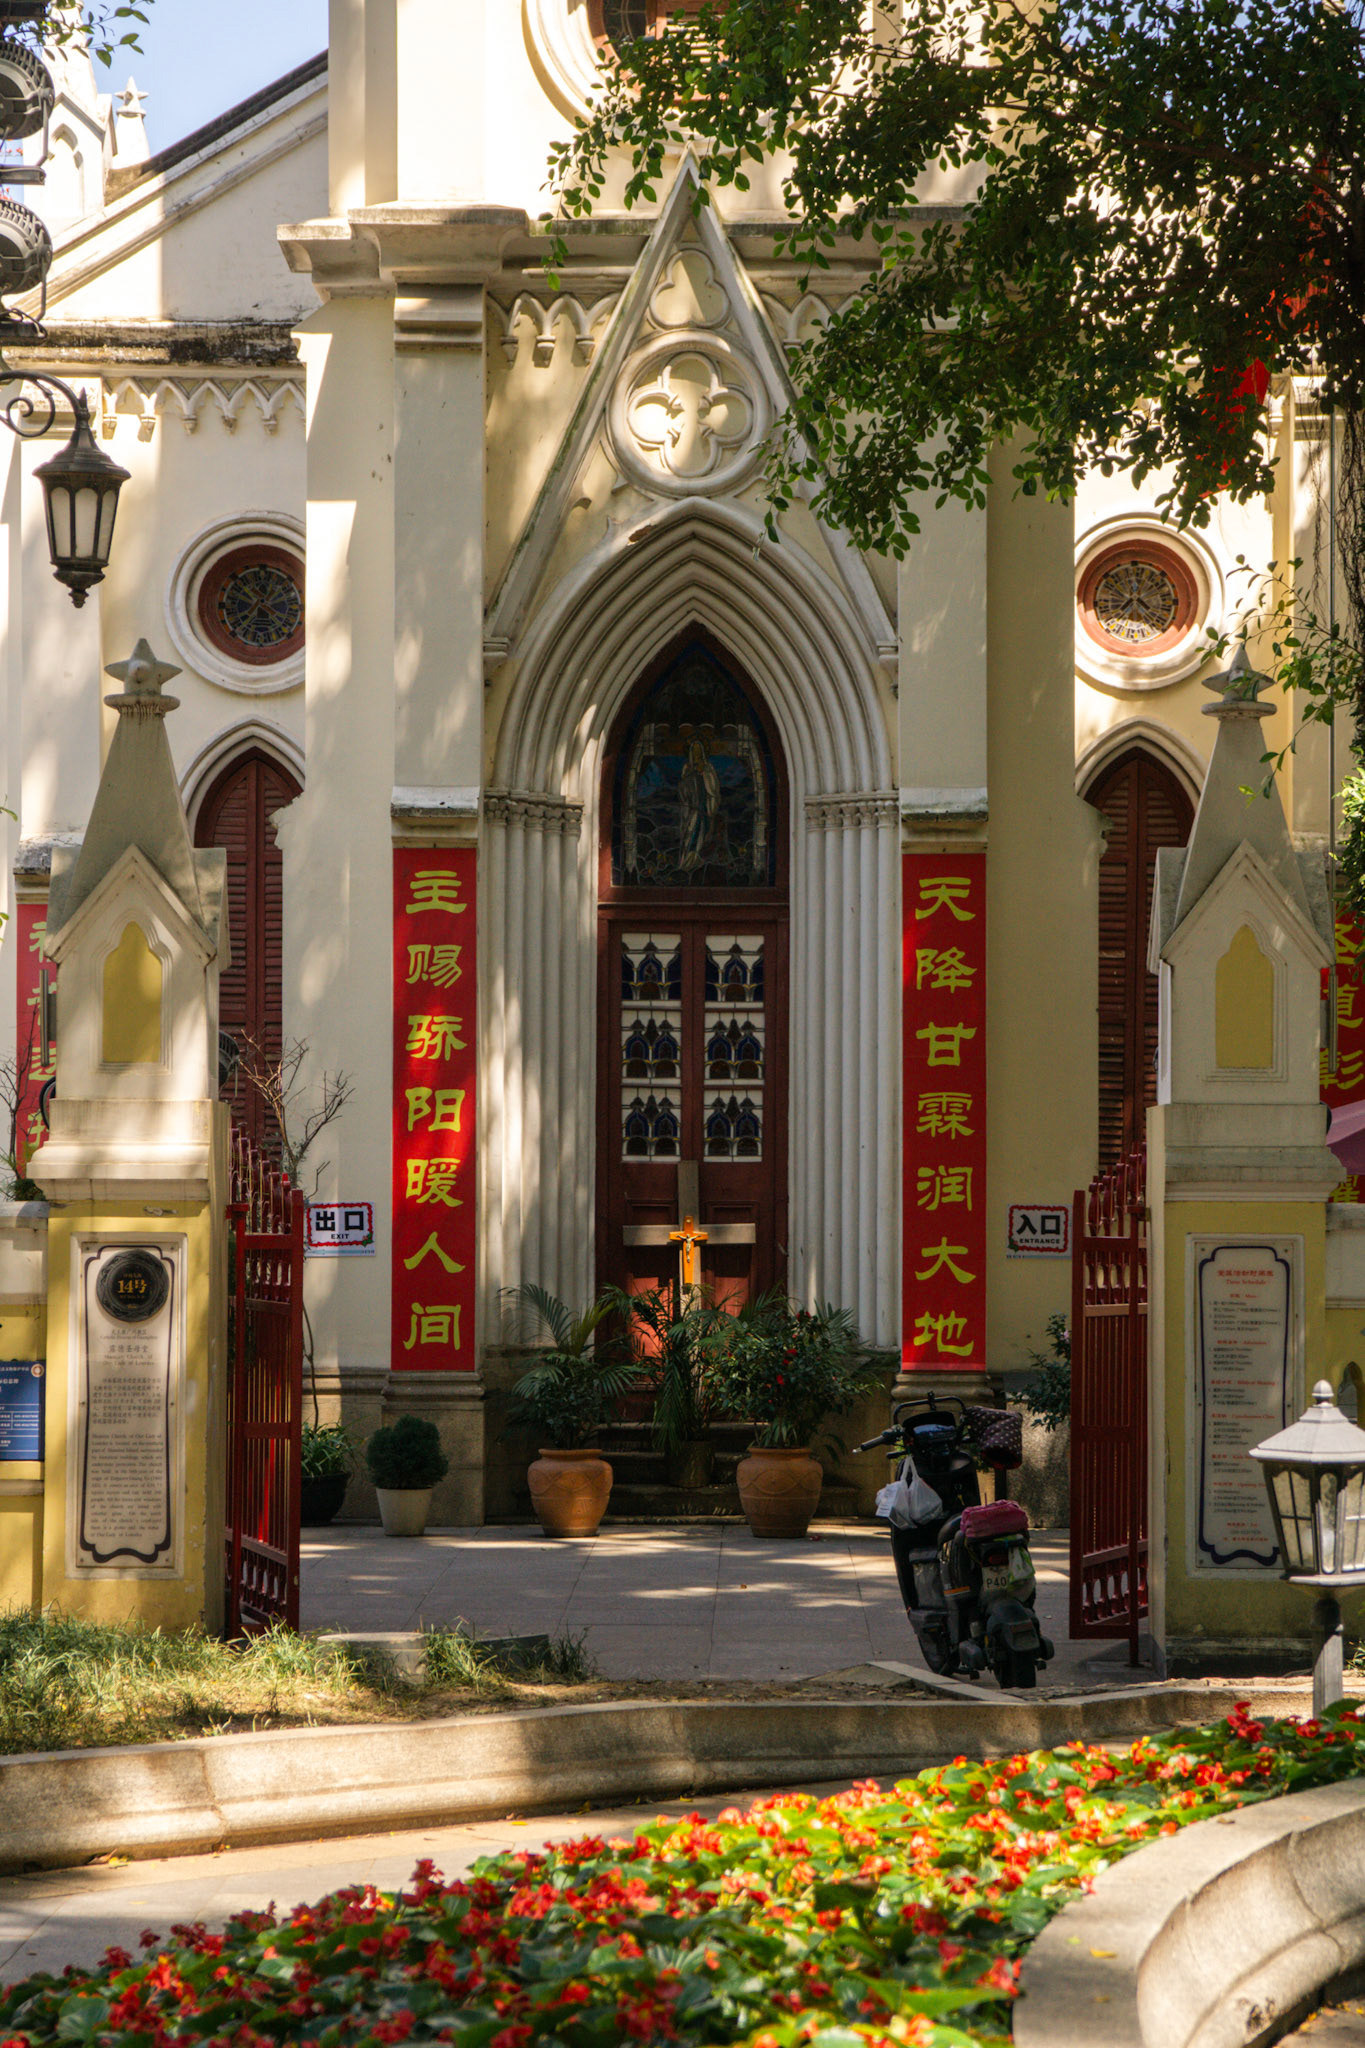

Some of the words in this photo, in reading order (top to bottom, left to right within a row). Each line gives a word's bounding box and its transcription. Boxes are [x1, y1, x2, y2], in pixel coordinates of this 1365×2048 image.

[404, 870, 467, 1350] 主赐骄阳暖人间
[915, 877, 977, 1356] 天降甘霖润大地
[316, 1211, 364, 1231] 出口
[1016, 1214, 1060, 1235] 入口
[117, 1279, 147, 1293] 14号
